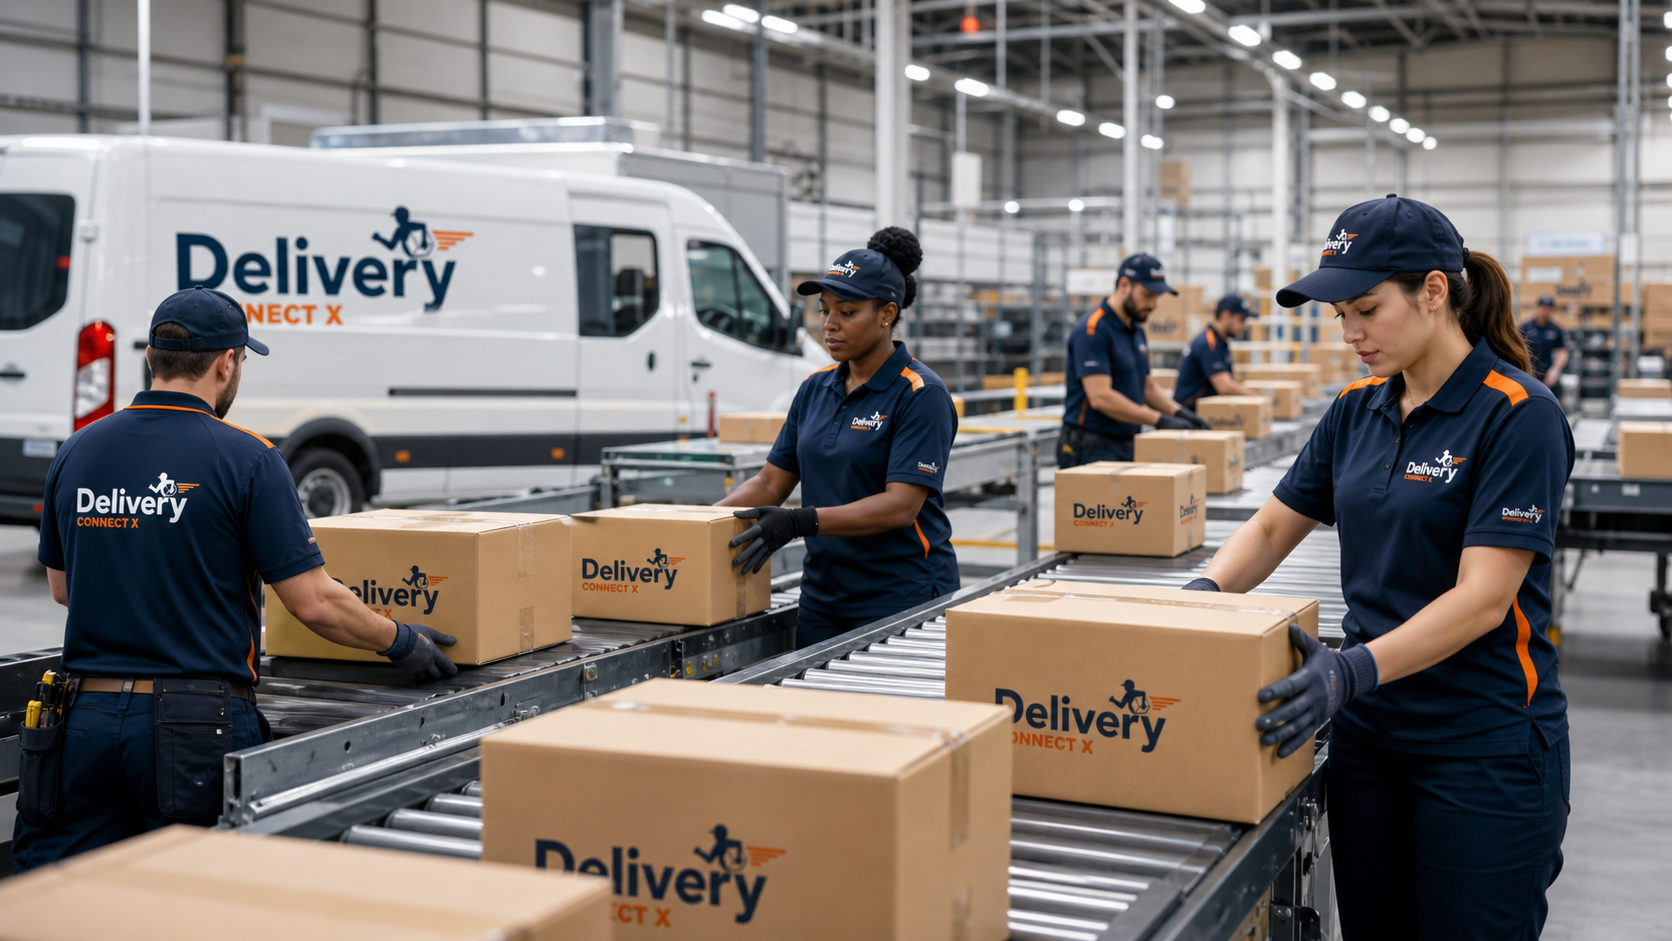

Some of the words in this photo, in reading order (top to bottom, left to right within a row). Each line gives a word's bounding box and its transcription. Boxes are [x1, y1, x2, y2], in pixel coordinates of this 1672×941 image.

[176, 232, 457, 315] Delivery
[241, 303, 317, 325] NECT
[326, 304, 343, 325] X
[1406, 461, 1458, 484] Delivery
[77, 487, 188, 523] Delivery
[1073, 503, 1143, 525] Delivery
[1502, 507, 1542, 523] Delivery
[77, 516, 129, 529] CONNECT
[131, 518, 139, 529] X
[1073, 520, 1107, 528] CONNECT
[582, 558, 677, 590] Delivery
[582, 582, 629, 593] CONNECT
[631, 585, 638, 594] X
[995, 688, 1166, 753] Delivery
[1081, 739, 1094, 755] X
[655, 907, 671, 928] X
